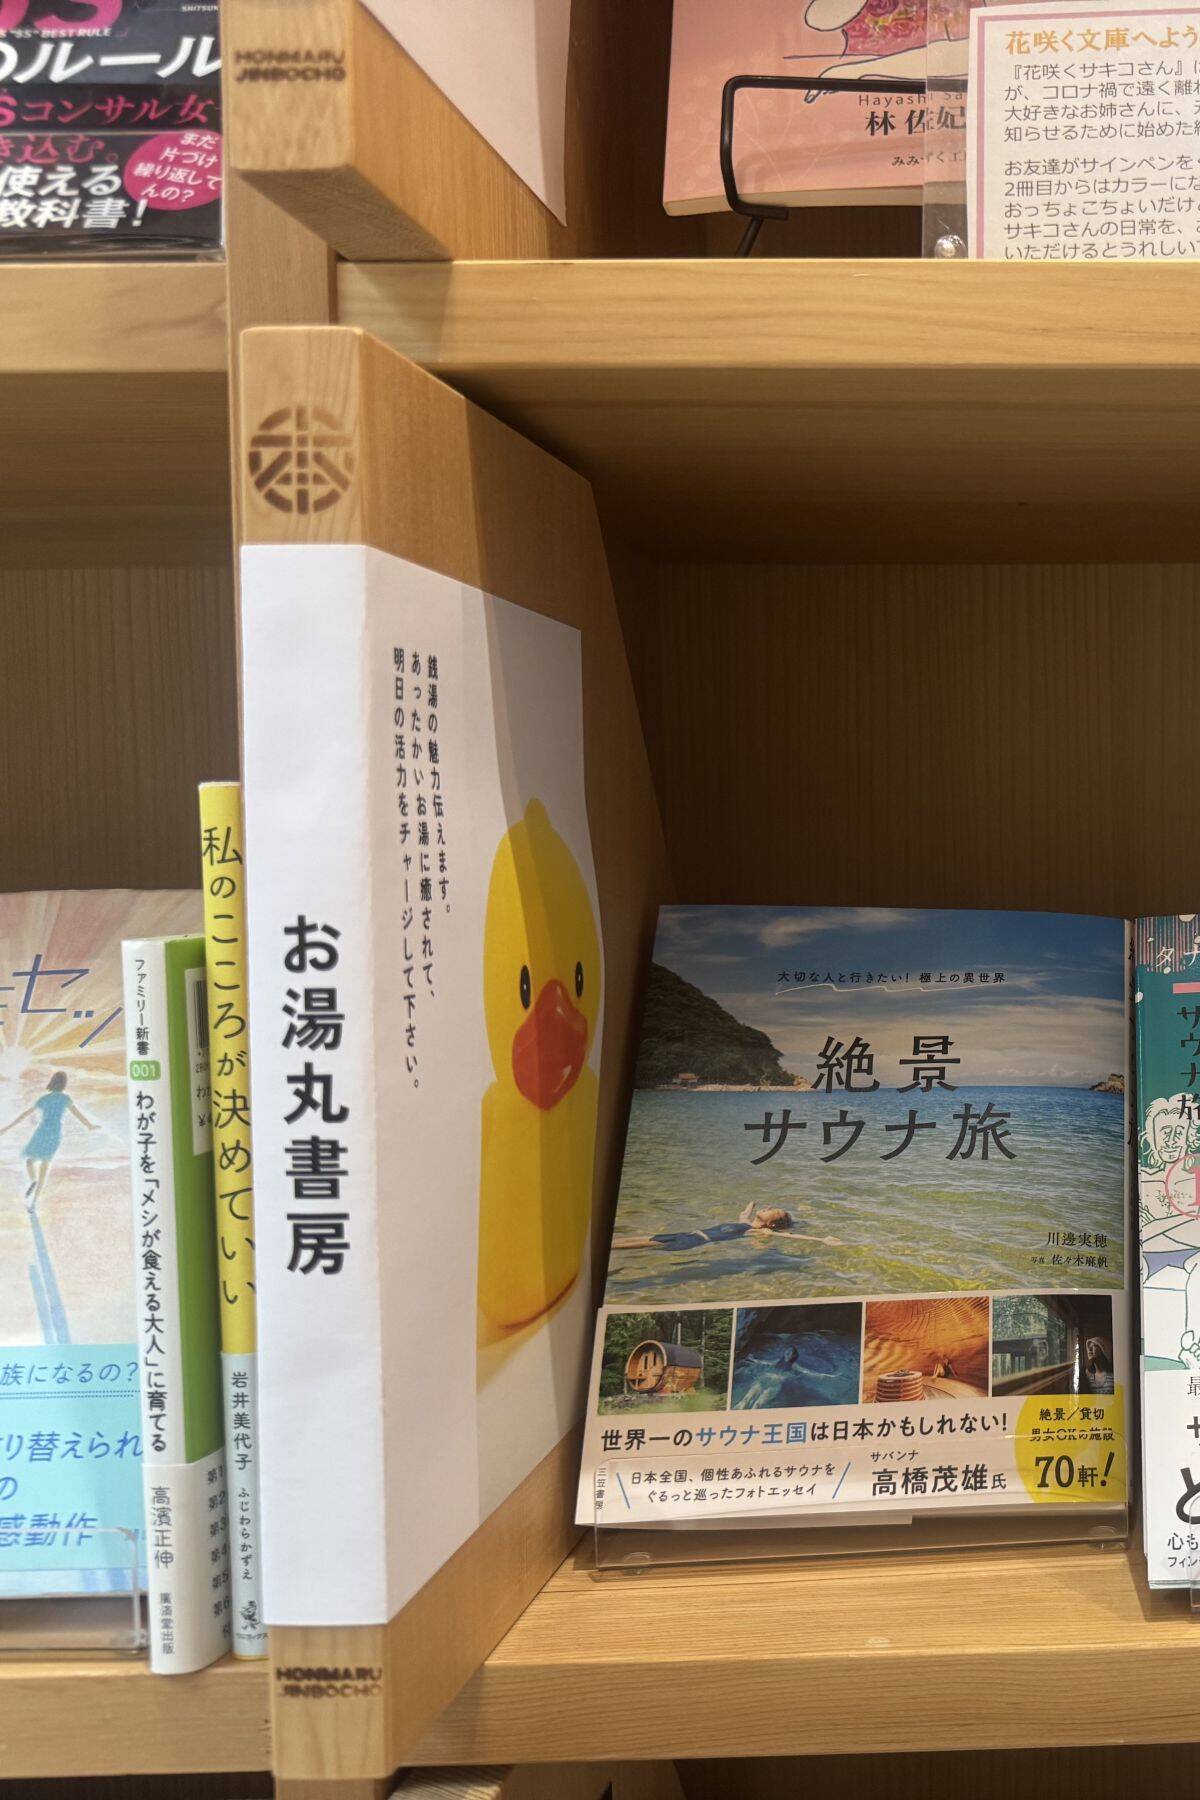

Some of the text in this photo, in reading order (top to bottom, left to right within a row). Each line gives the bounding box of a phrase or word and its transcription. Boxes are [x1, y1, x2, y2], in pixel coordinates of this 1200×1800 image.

[42, 29, 76, 37] BEST
[78, 28, 112, 37] RULE
[161, 148, 218, 168] 片づけ
[181, 133, 217, 149] まだ
[0, 165, 122, 198] 使える
[133, 163, 221, 190] 繰り返して
[141, 186, 194, 202] んの?
[427, 654, 450, 913] 銭湯の魅力伝えます。
[411, 651, 435, 998] あったかいお湯に癒されて、
[394, 647, 419, 1089] 明日の活力をチャージして下さい。
[778, 971, 1007, 985] 大切な人と行きたい! 極上の異世界
[135, 960, 149, 1056] ファミリー新書
[132, 1063, 157, 1077] 001
[202, 825, 256, 1304] 私のこころが決めていい
[811, 1035, 962, 1094] 絶景
[282, 914, 350, 1276] お湯丸書房
[744, 1102, 1018, 1166] サウナ旅
[136, 1091, 168, 1452] わが子を「メシが食える大人」に育てる
[231, 1371, 252, 1471] 岩井美代子
[601, 1412, 1008, 1452] 世界一のサウナ王国は日本かもしれない!
[631, 1462, 837, 1485] 日本全国、個性あふれるサウナを
[870, 1450, 919, 1462] サバンナ
[1034, 1451, 1115, 1489] 70軒!
[647, 1484, 817, 1504] ぐるっと巡ったフォトエッセイ
[238, 1488, 252, 1580] ふじわらかずえ
[276, 1667, 382, 1682] HONMARU
